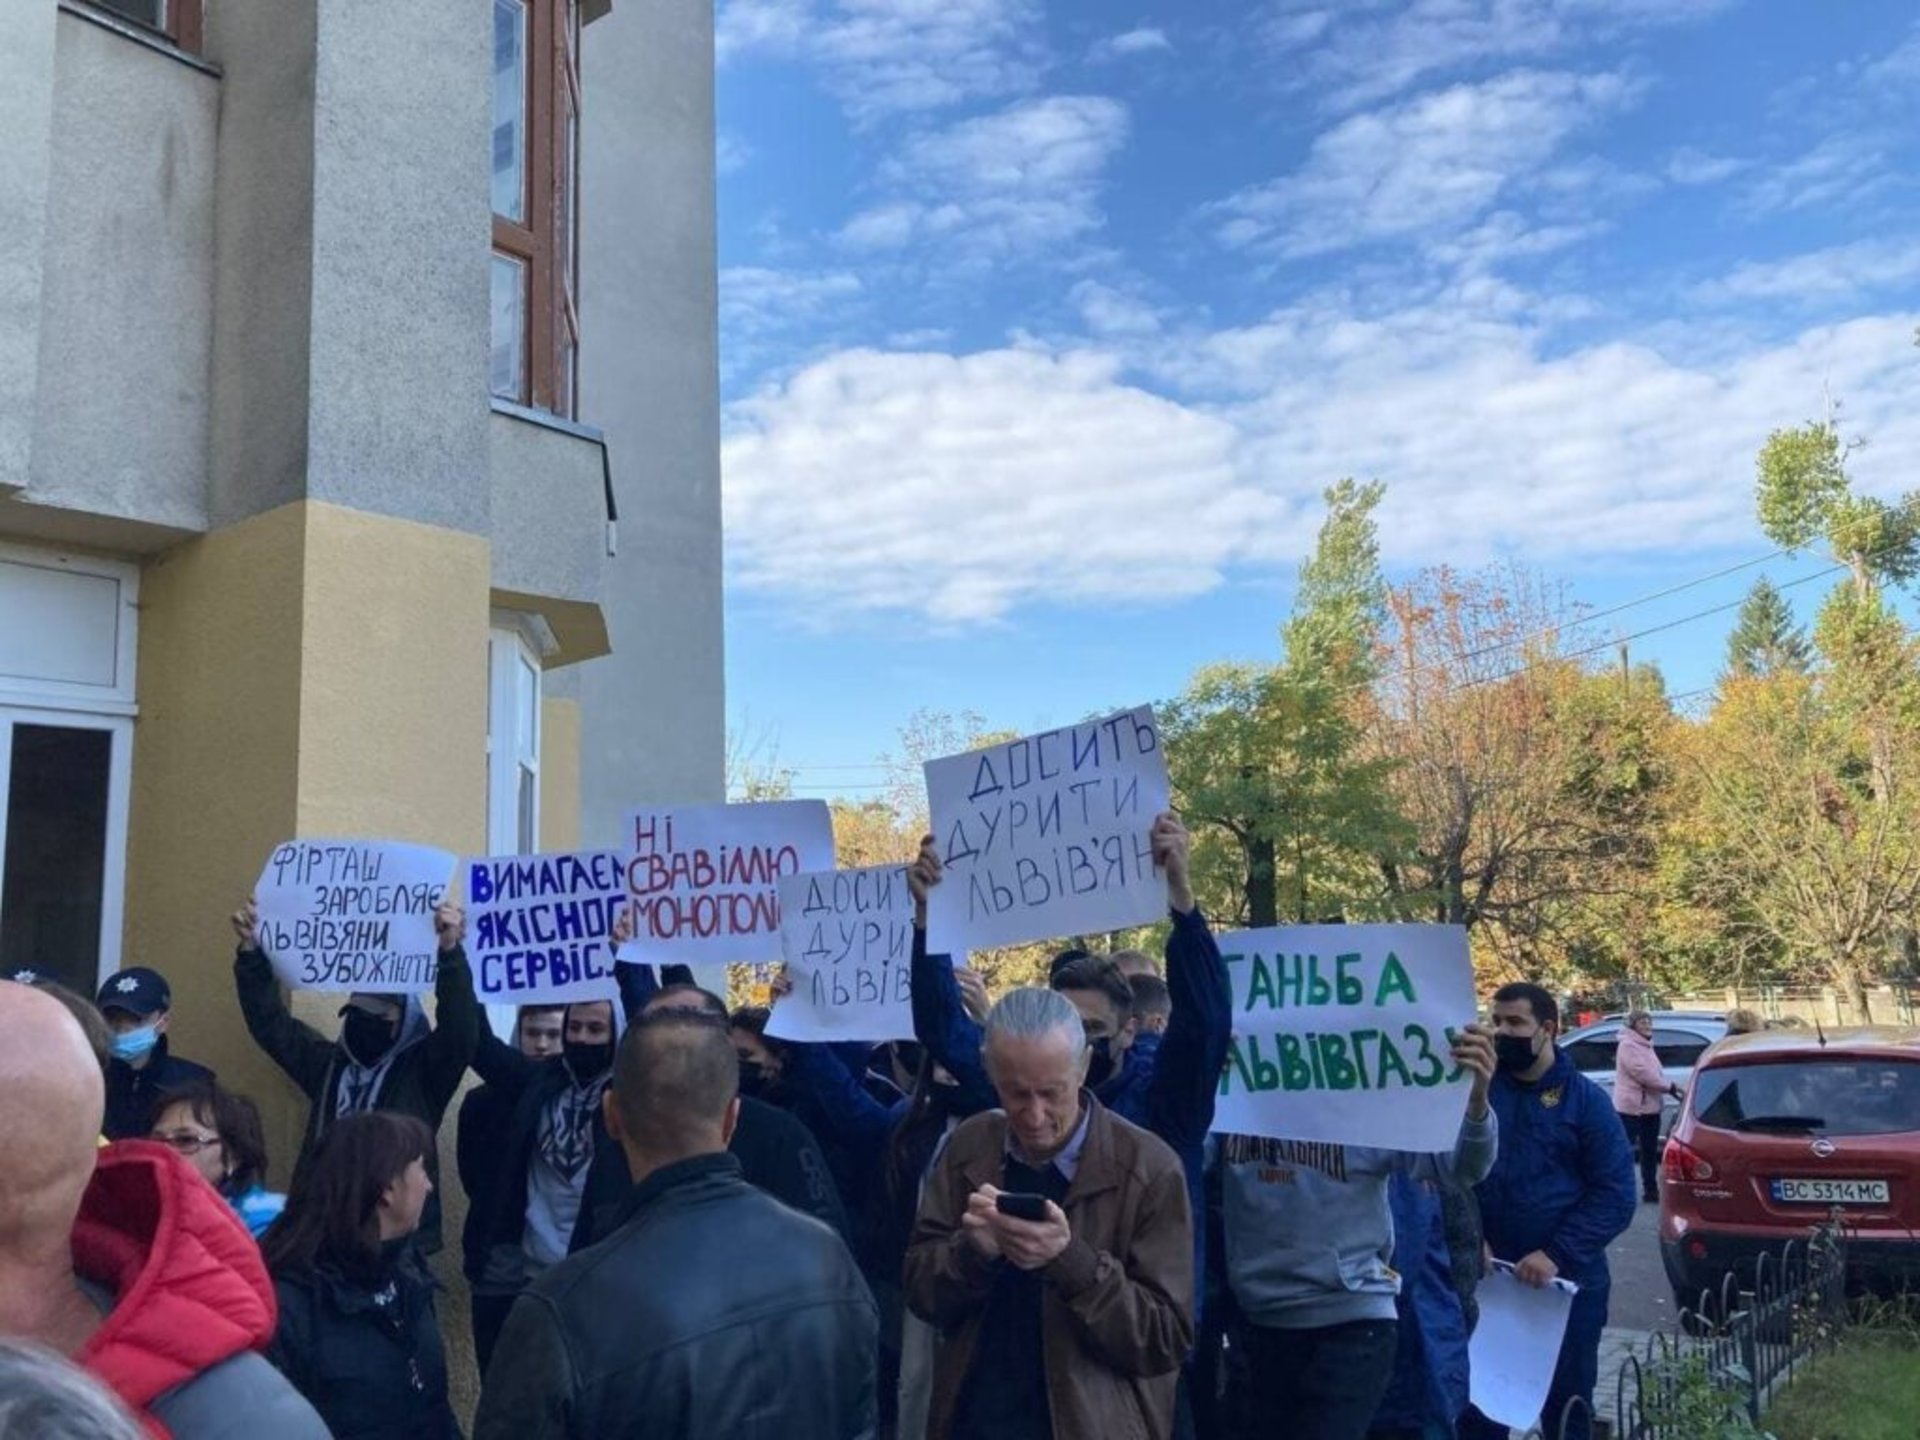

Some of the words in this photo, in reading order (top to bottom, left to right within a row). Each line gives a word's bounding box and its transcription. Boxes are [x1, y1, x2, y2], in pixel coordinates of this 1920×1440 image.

[968, 714, 1156, 803] ДОСИТЬ
[944, 775, 1139, 869] ДУРИТИ
[309, 883, 446, 916] ЗАРОБЛЯЄ
[632, 889, 781, 939] МОНОПОЛІ
[481, 943, 614, 992] СЕРВІС
[1783, 1182, 1809, 1199] BC
[1812, 1182, 1855, 1200] 5314
[1857, 1183, 1885, 1201] MC
